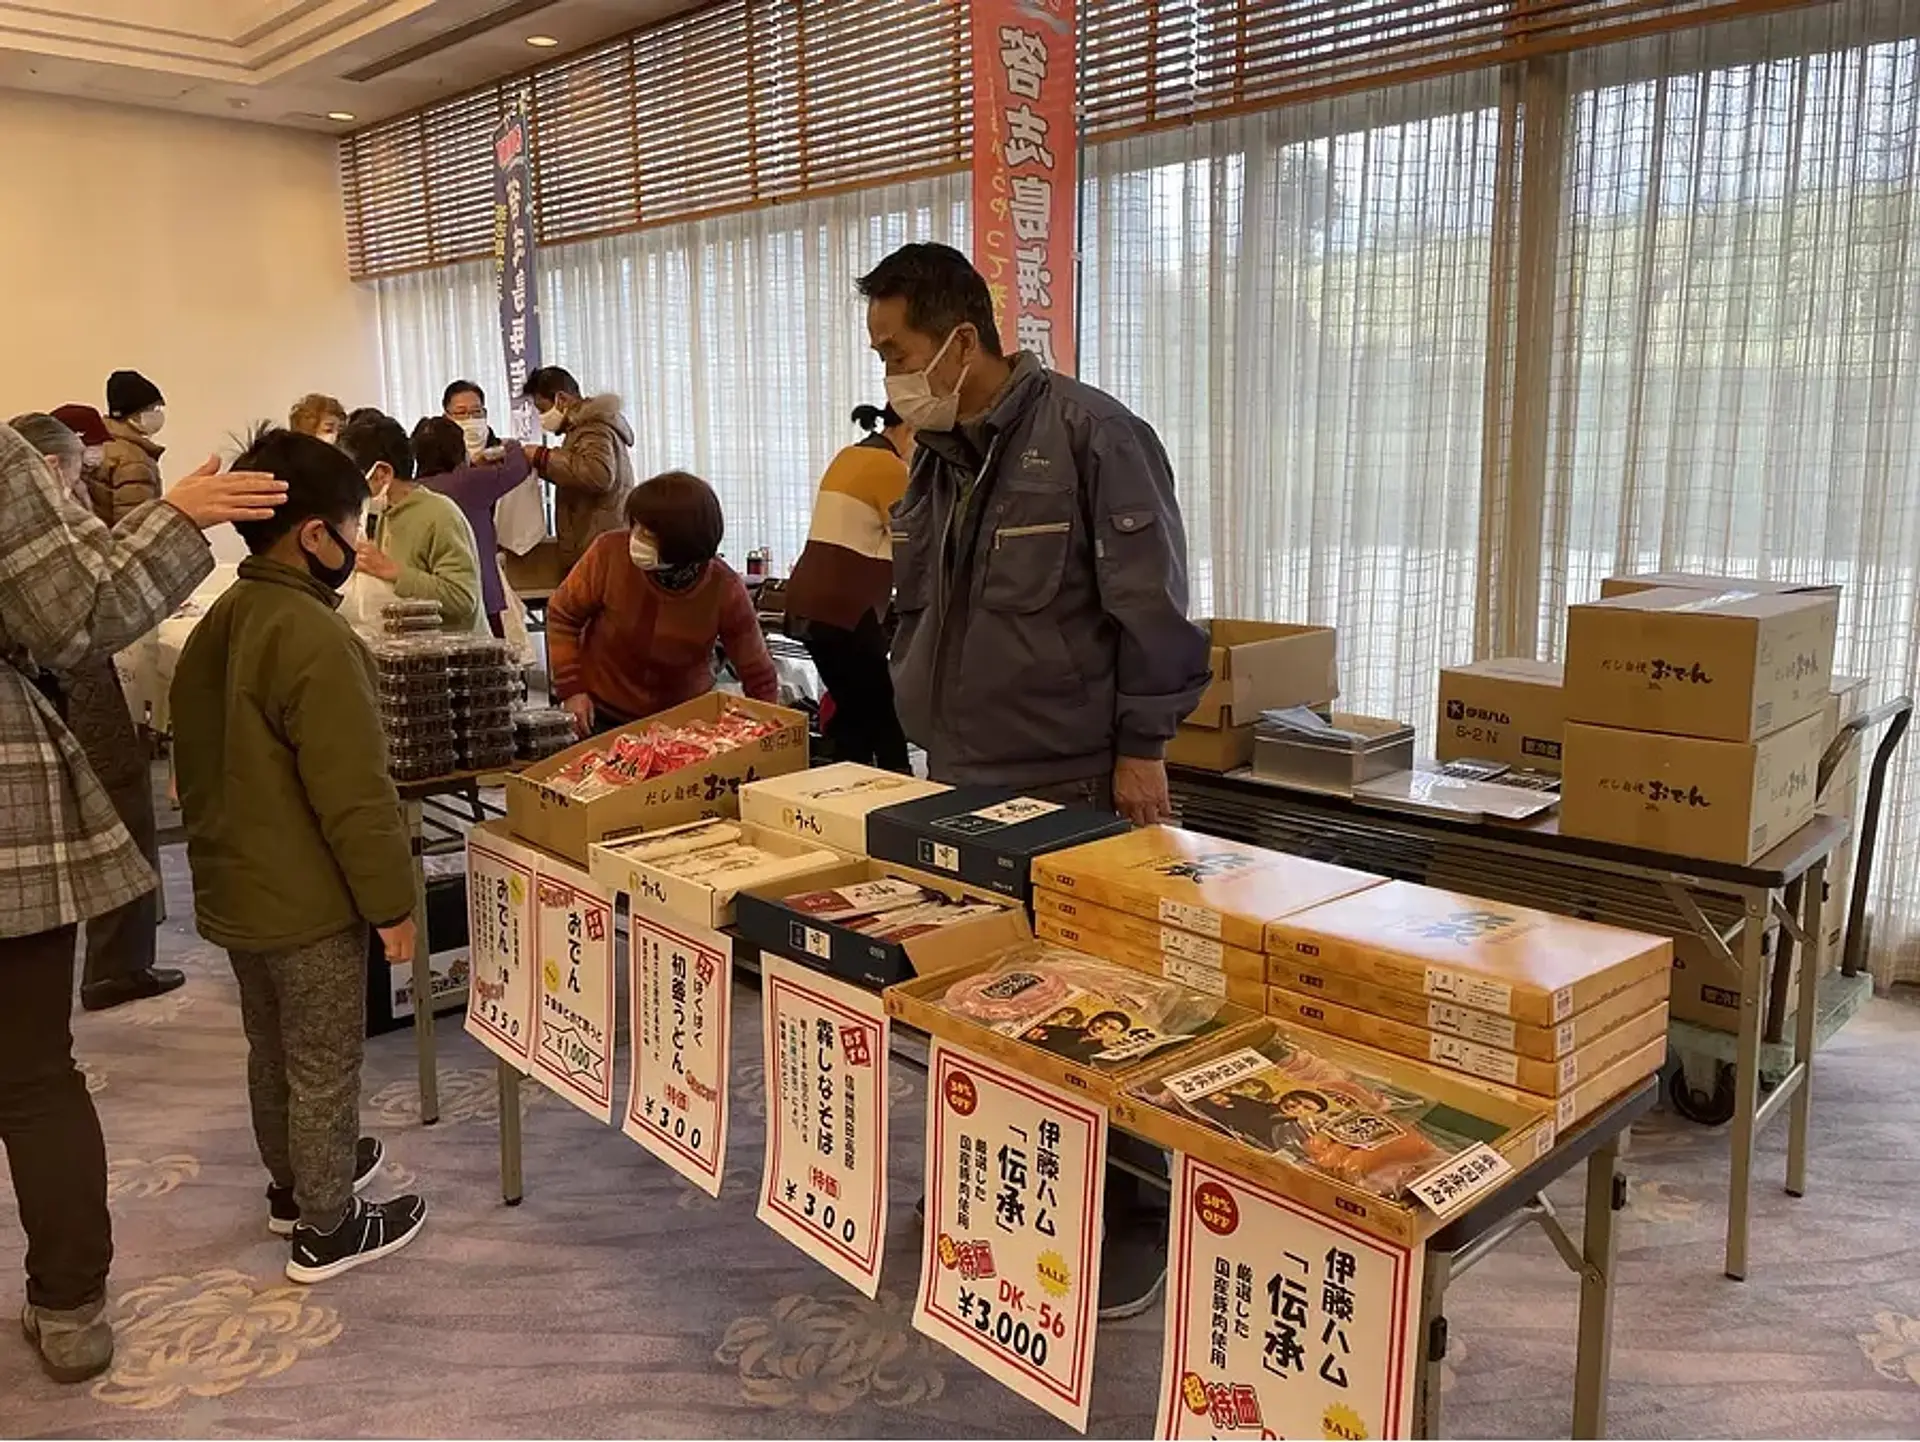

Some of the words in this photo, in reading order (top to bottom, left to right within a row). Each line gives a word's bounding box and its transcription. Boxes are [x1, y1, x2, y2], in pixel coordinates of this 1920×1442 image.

[567, 911, 582, 993] おでん
[645, 1095, 702, 1149] ¥300
[785, 1177, 856, 1243] ¥300
[996, 1124, 1028, 1235] 「伝承」
[1035, 1117, 1061, 1237] 伊藤ハム
[1203, 1209, 1231, 1229] OFF
[998, 1278, 1066, 1338] DK-56
[1036, 1262, 1068, 1285] SALE
[1209, 1256, 1231, 1370] 国産豚肉使用
[1234, 1262, 1252, 1339] 厳選した
[1262, 1250, 1310, 1380] 「伝承」
[1318, 1246, 1356, 1388] 伊藤ハム
